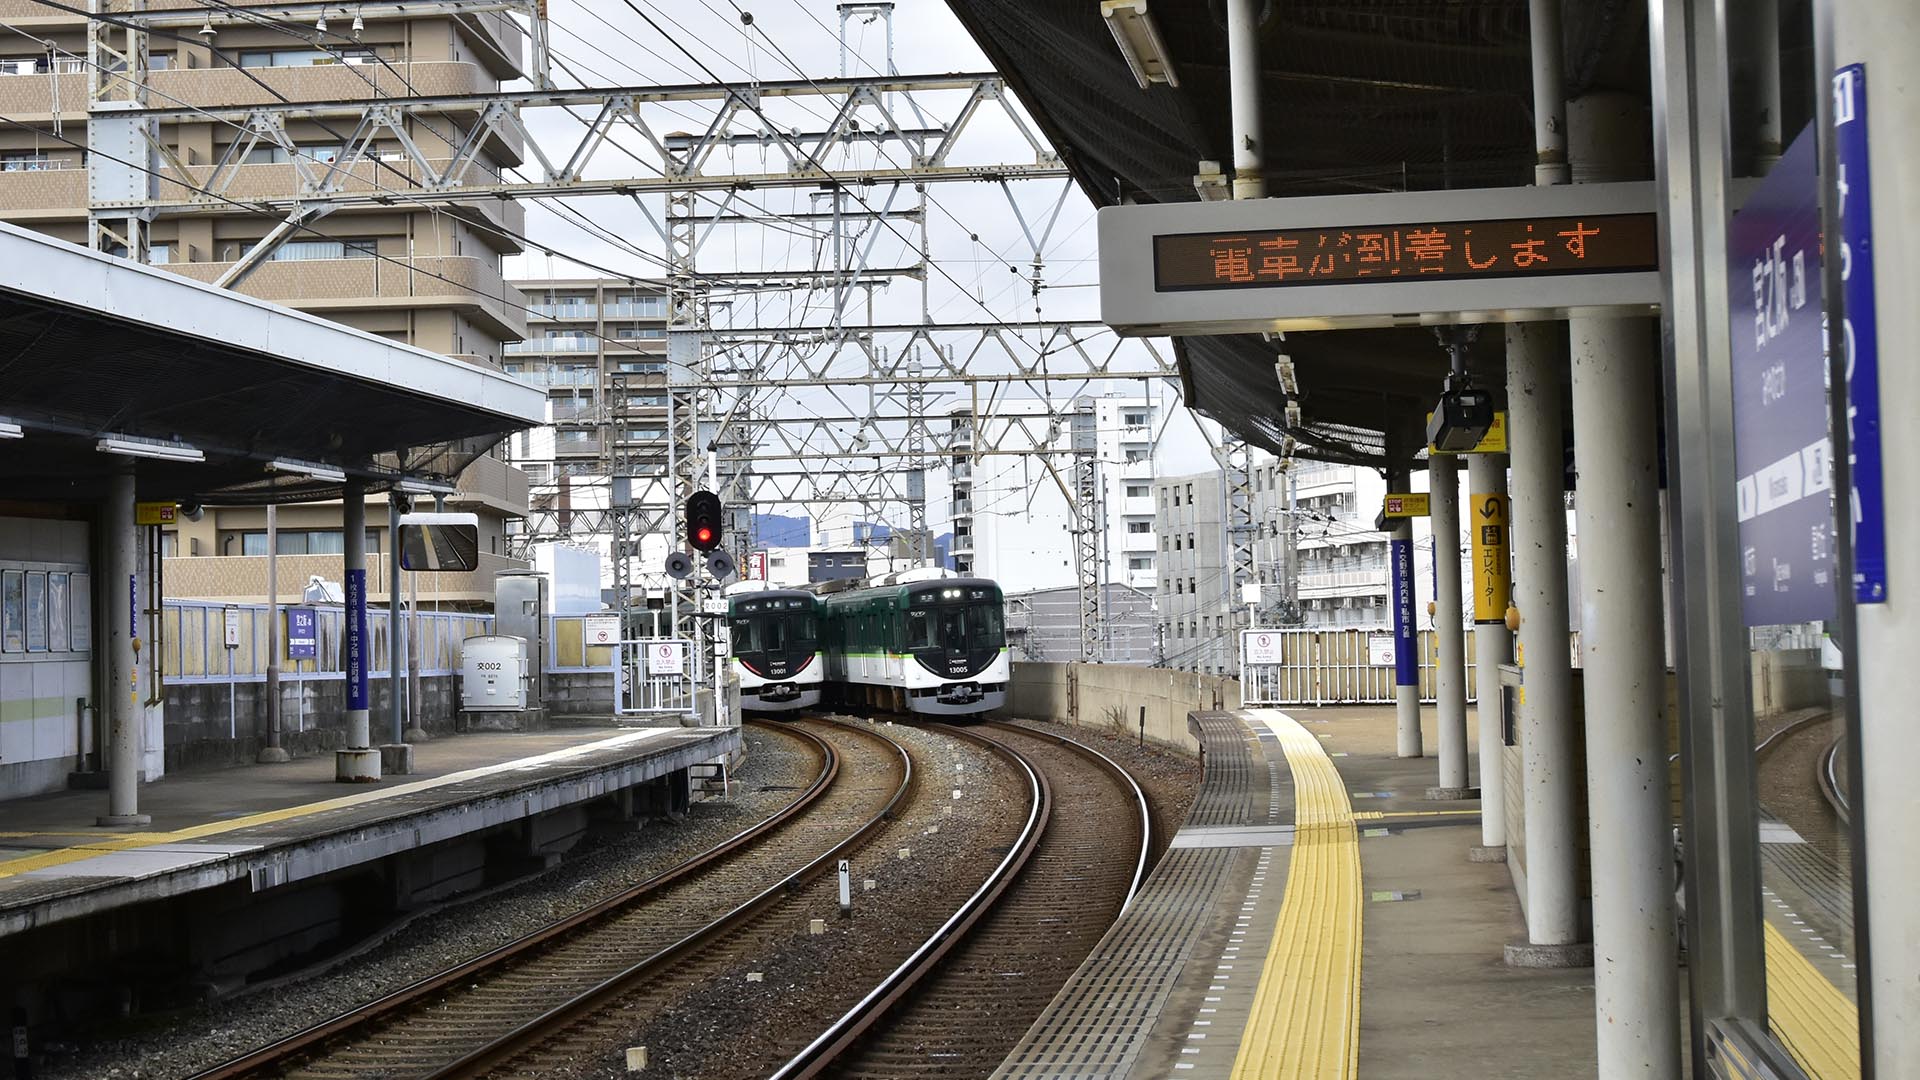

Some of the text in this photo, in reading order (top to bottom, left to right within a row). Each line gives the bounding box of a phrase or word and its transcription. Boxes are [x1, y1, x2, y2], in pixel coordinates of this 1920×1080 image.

[1212, 222, 1601, 282] 電車が到着します
[1400, 545, 1405, 553] 2
[1483, 548, 1494, 607] エレベーター
[949, 666, 968, 674] 13005
[840, 862, 848, 874] 4
